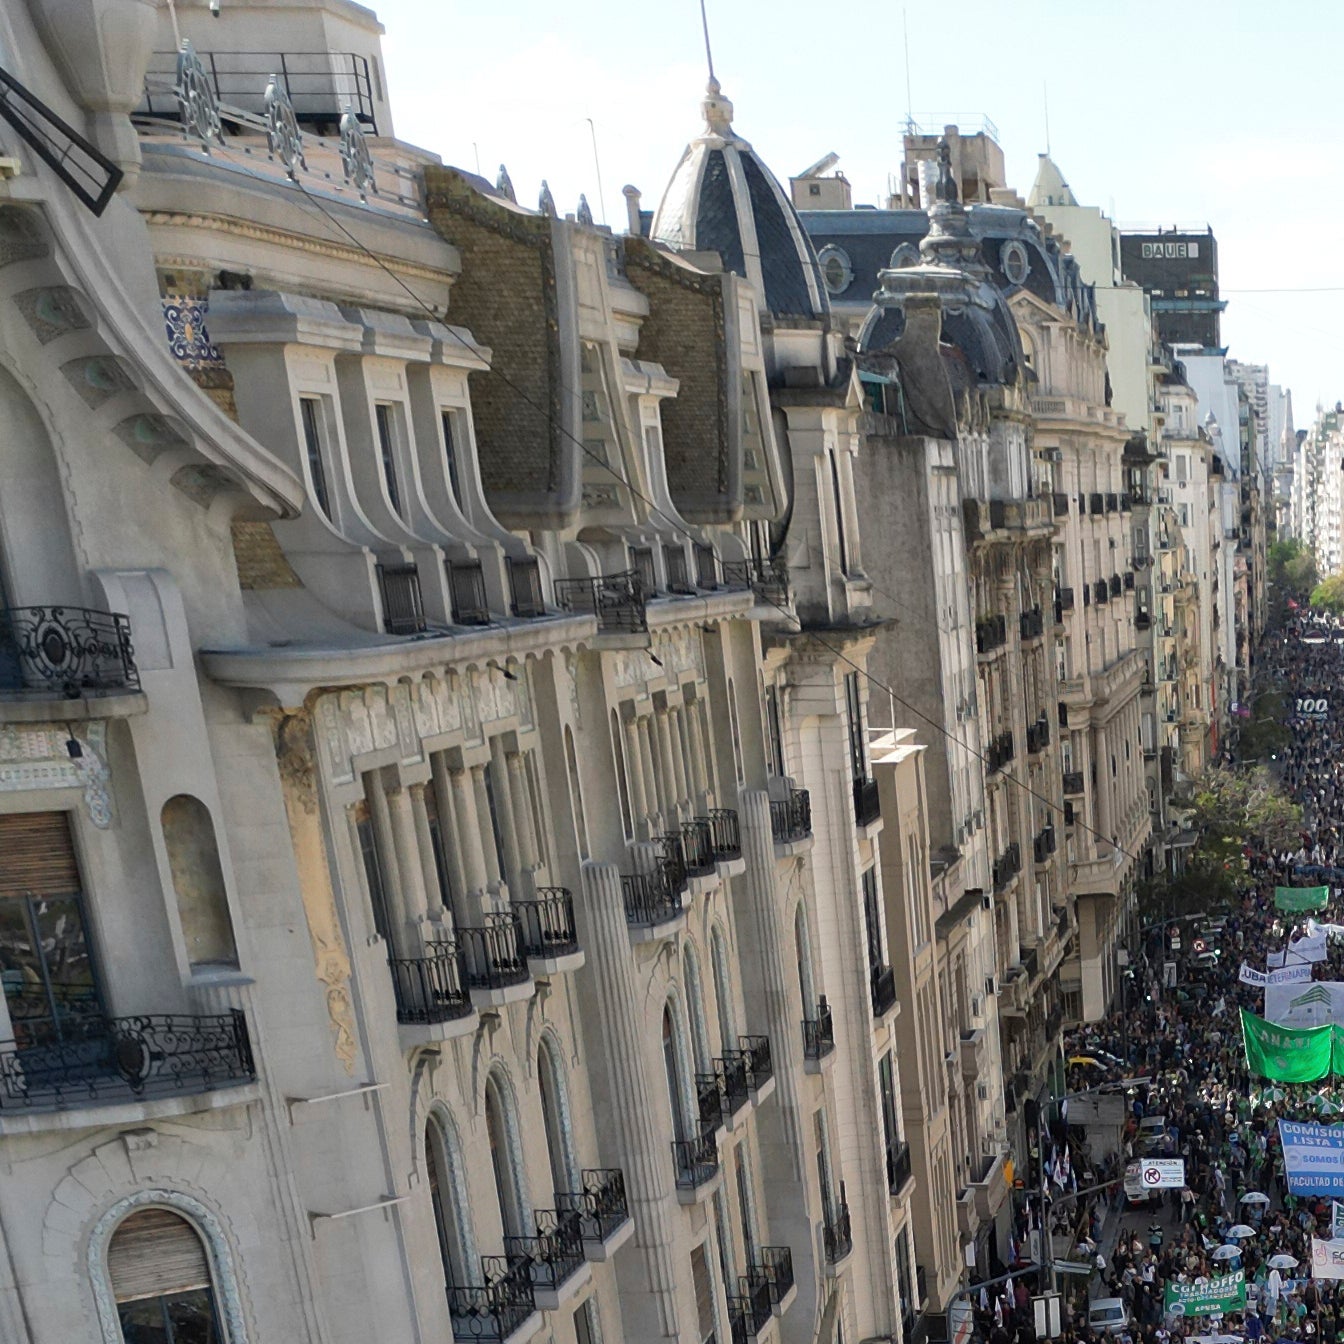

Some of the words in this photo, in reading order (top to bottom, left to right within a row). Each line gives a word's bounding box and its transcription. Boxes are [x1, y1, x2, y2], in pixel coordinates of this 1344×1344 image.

[1293, 1136, 1331, 1146] LISTA
[1303, 1155, 1338, 1164] SOMOS
[1289, 1175, 1331, 1187] FACULTAD
[1333, 1176, 1344, 1187] DE
